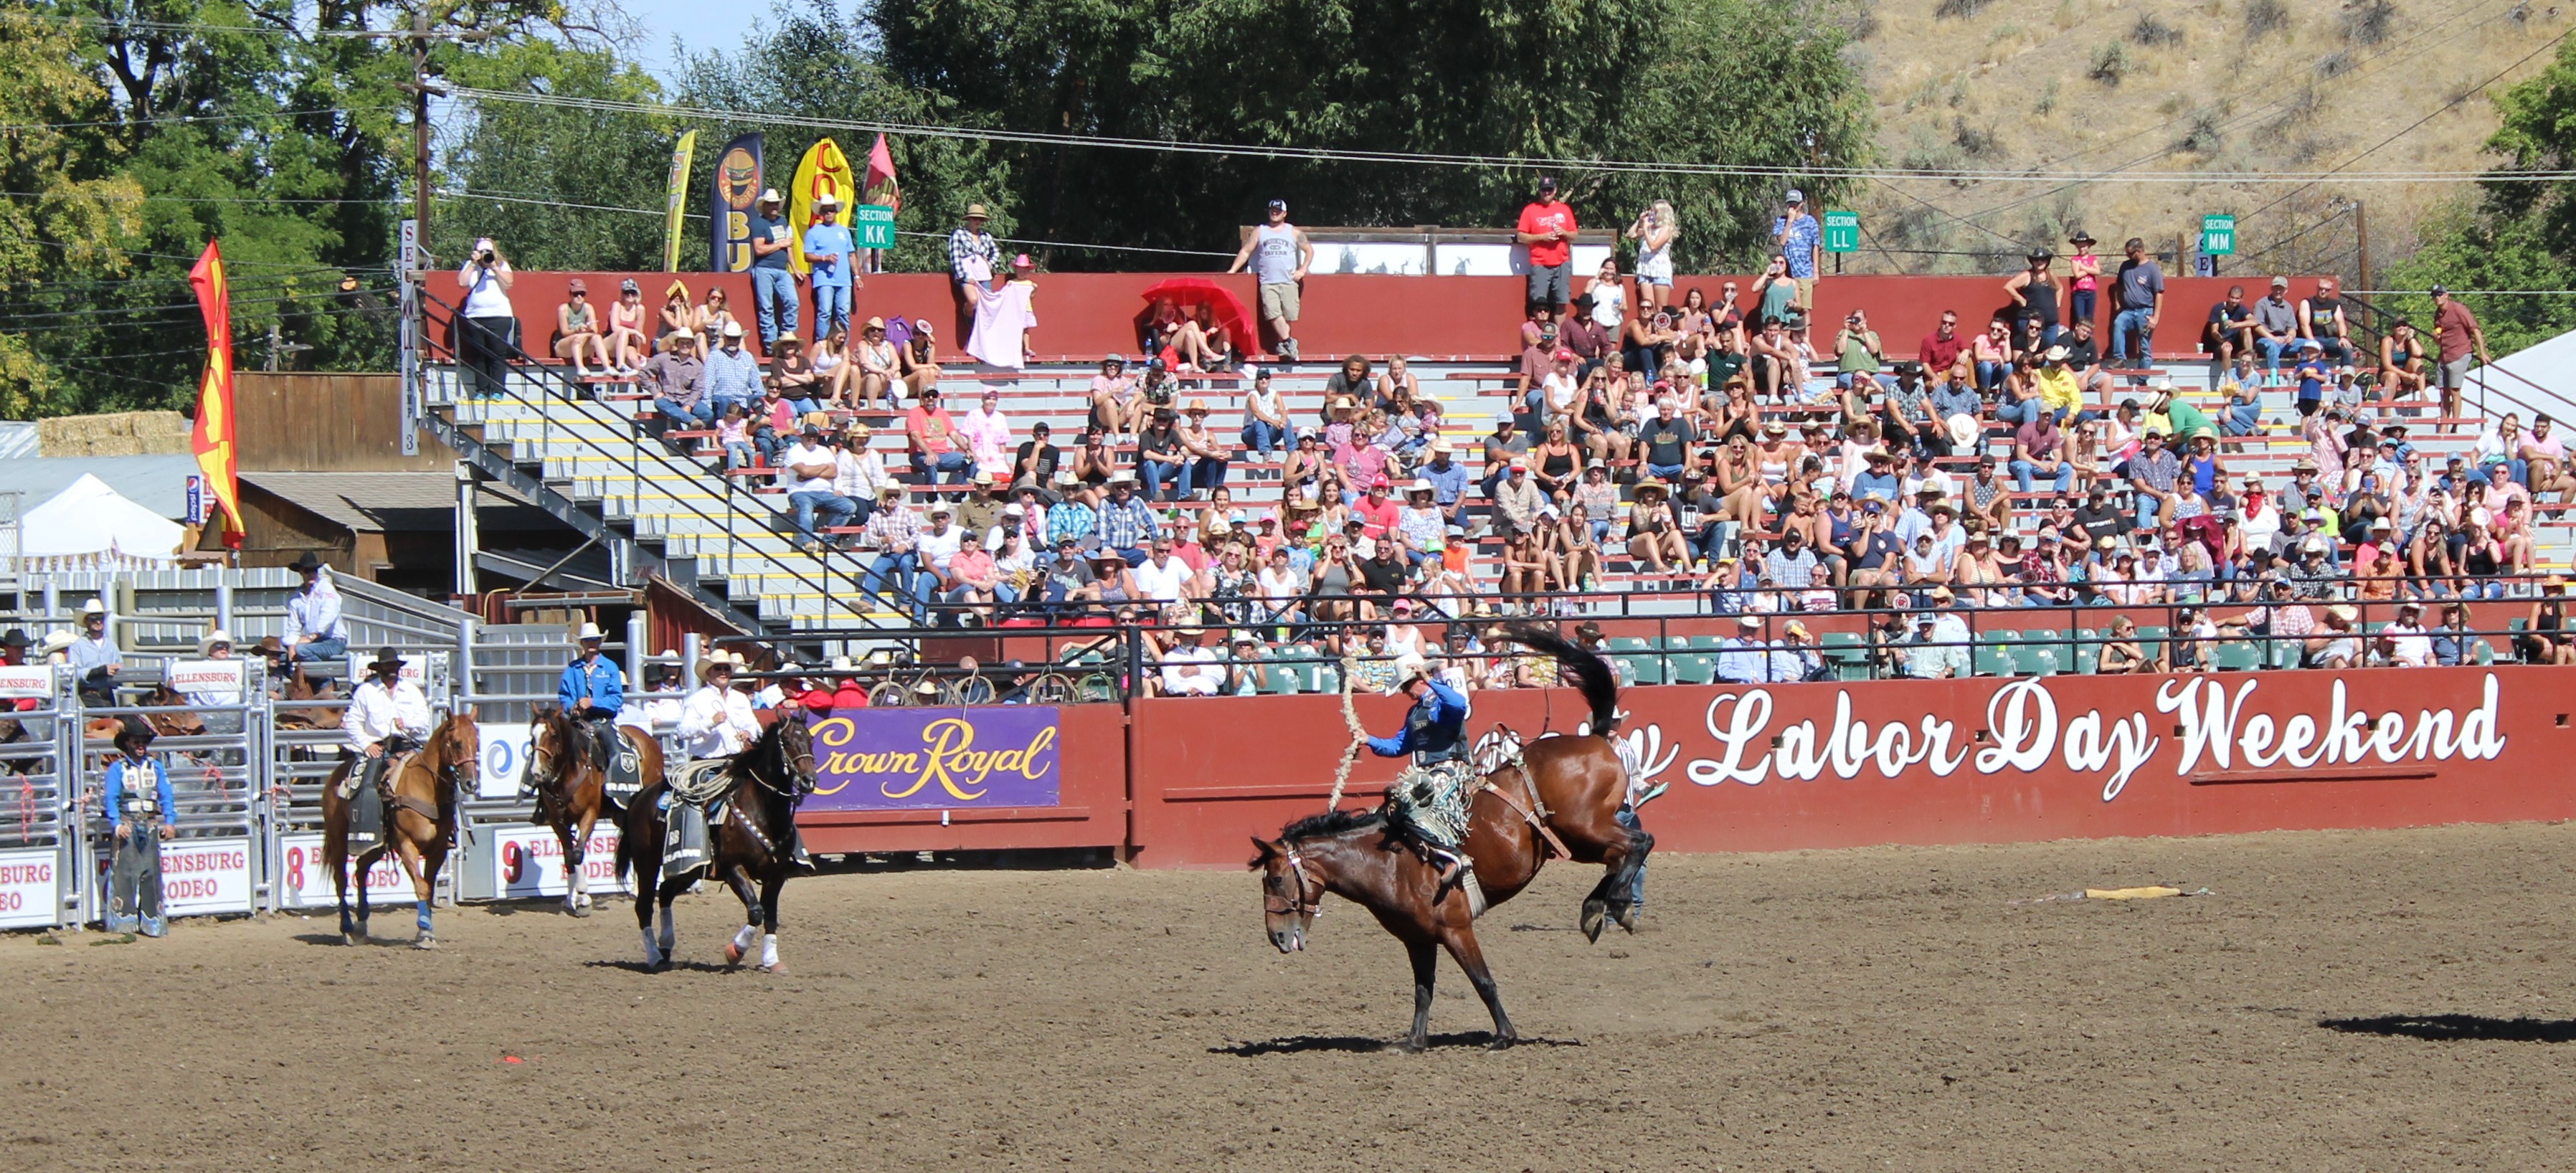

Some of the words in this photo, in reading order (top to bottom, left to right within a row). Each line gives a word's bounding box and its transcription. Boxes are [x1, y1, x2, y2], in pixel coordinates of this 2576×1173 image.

[859, 209, 894, 222] SECTION
[1826, 216, 1857, 227] SECTION
[2205, 219, 2234, 229] SECTION
[866, 225, 886, 244] KK
[1833, 230, 1850, 247] LL
[2209, 233, 2229, 250] MM
[406, 434, 414, 450] 3
[189, 493, 198, 522] pepsi
[0, 678, 47, 689] ENSBURG
[175, 673, 237, 684] ELLENSBURG
[1686, 689, 1970, 786] Labor
[1974, 675, 2160, 802] Day
[2155, 672, 2507, 777] Weekend
[808, 717, 920, 795] Crown
[881, 717, 1057, 801] Royal
[605, 783, 641, 792] RAM
[161, 852, 245, 873] ENSBURG
[502, 840, 523, 884] 9
[664, 849, 701, 863] RAM
[287, 847, 305, 891] 8
